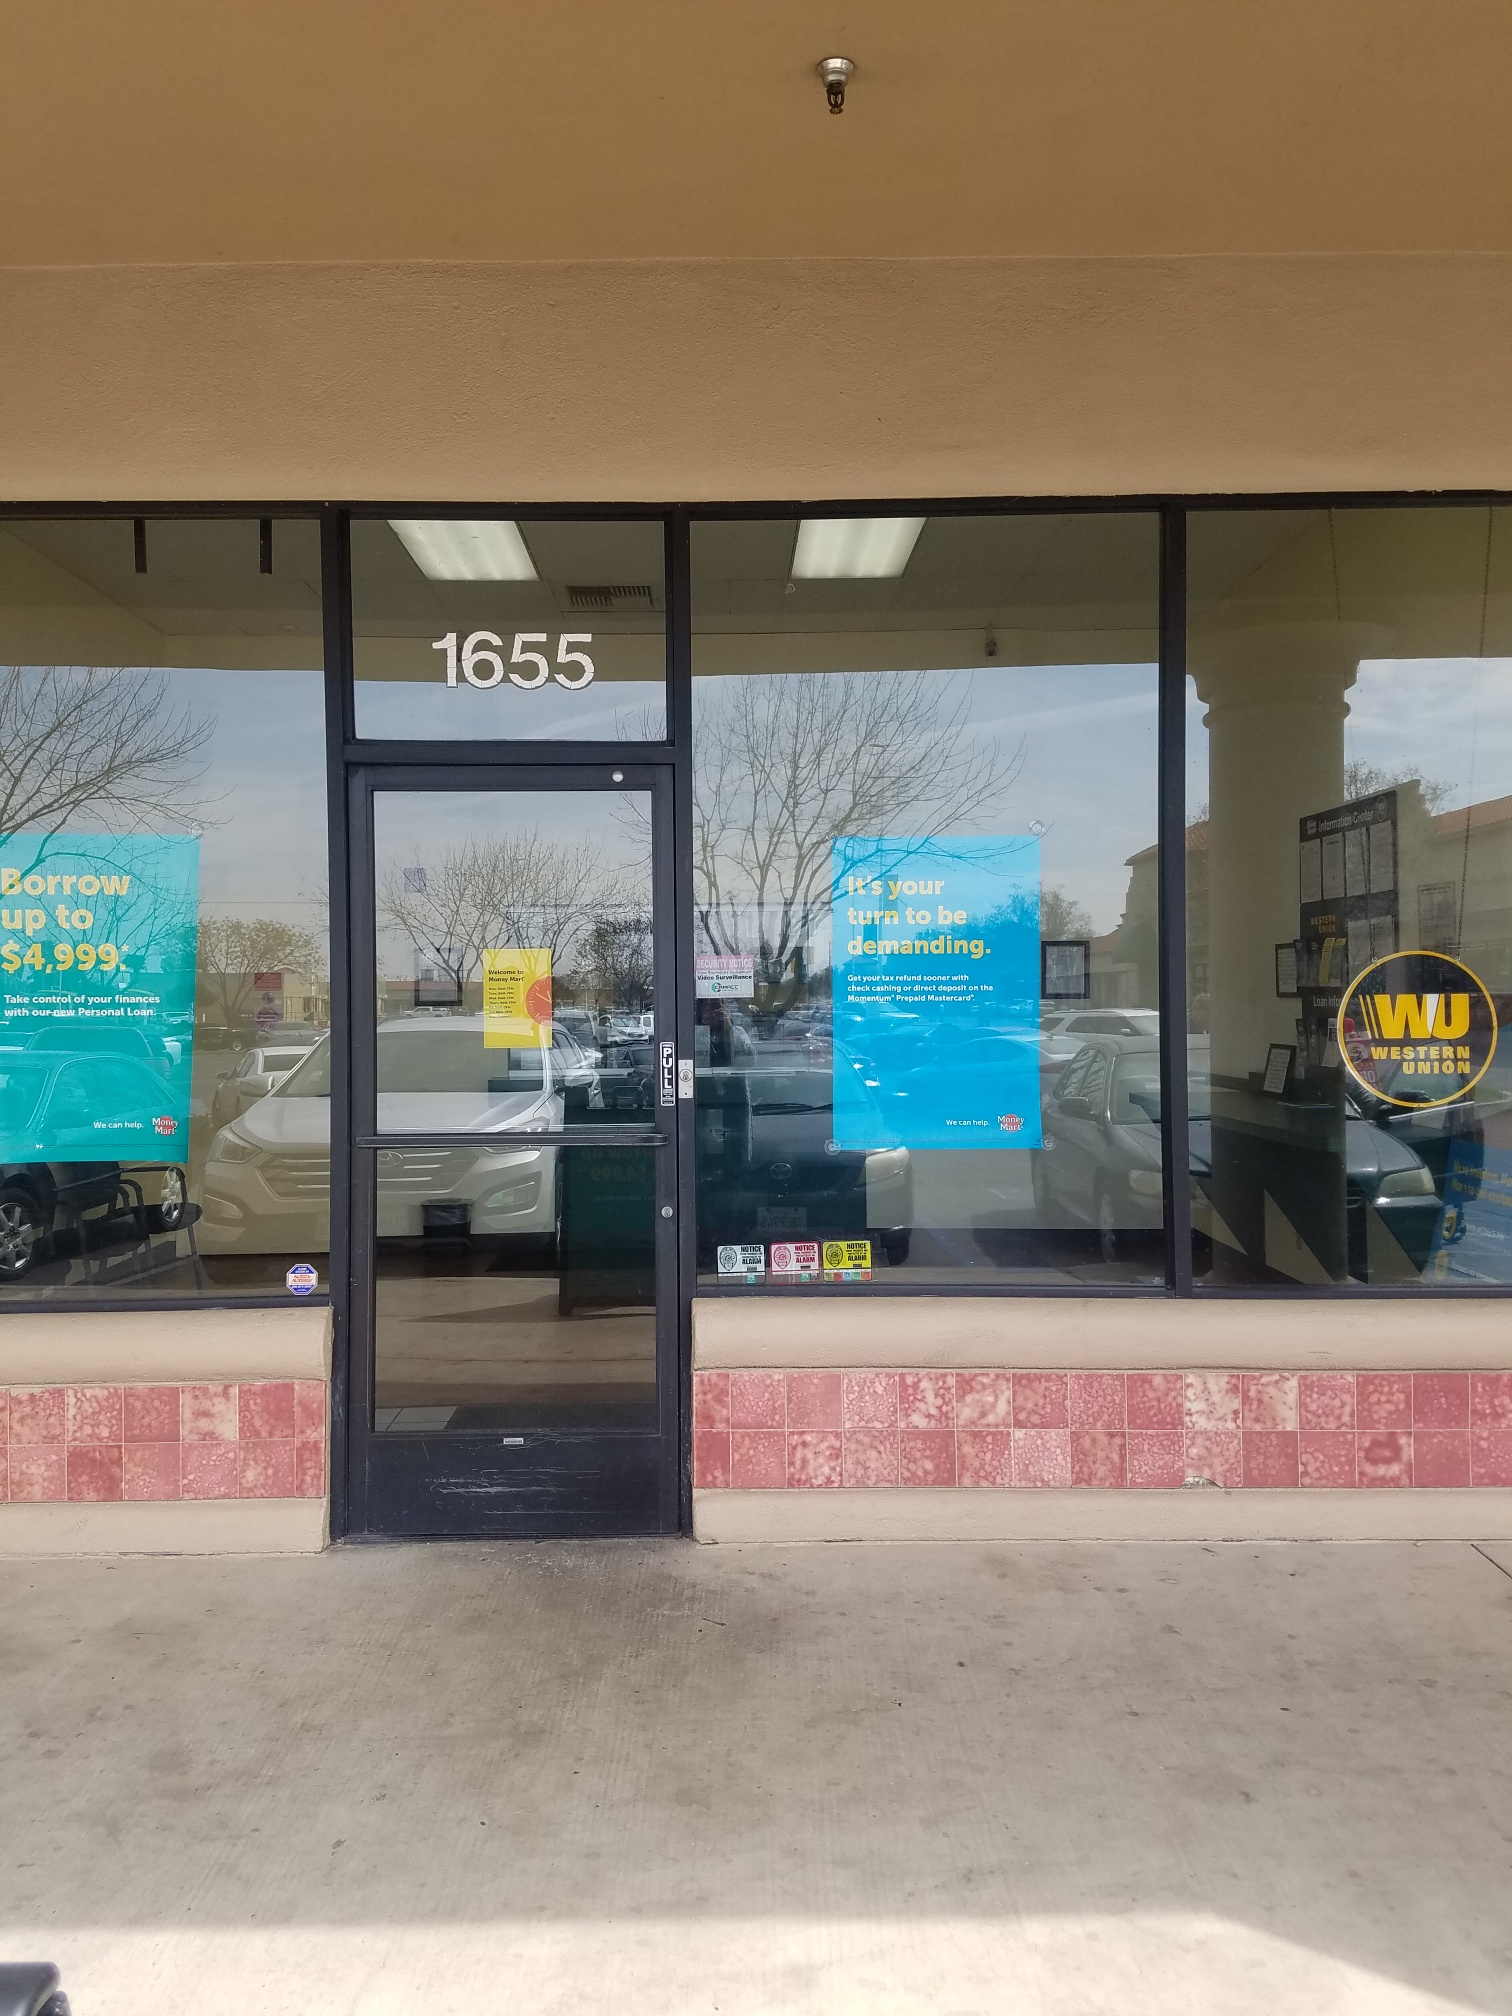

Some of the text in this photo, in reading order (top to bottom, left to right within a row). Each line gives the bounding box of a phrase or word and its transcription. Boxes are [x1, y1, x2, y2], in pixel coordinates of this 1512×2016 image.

[432, 631, 595, 690] 1655
[1319, 815, 1352, 832] Information
[1353, 809, 1374, 824] Center
[1, 868, 131, 895] Borrow
[848, 876, 945, 900] It's your
[1, 904, 94, 936] up to
[847, 905, 967, 925] turn to be
[1310, 913, 1336, 926] WESTERN
[1318, 922, 1336, 935] UNION
[847, 935, 992, 960] demanding.
[696, 958, 753, 969] SECURITY NOTICE
[847, 984, 871, 992] check
[872, 984, 902, 993] cashing
[913, 984, 936, 992] direct
[938, 984, 967, 993] deposit
[4, 995, 160, 1006] Take control of your finances
[896, 994, 926, 1003] Prepaid
[1313, 996, 1328, 1007] Loan
[4, 1007, 157, 1017] with our new Personal Loan.
[1373, 993, 1470, 1040] WU
[1370, 1046, 1470, 1060] WESTERN
[663, 1047, 673, 1089] PULL
[1402, 1060, 1471, 1075] UNION
[93, 1121, 106, 1129] We
[124, 1121, 144, 1130] help.
[152, 1117, 179, 1128] Money
[972, 1119, 990, 1127] help.
[997, 1115, 1025, 1125] Money
[740, 1245, 762, 1253] NOTICE
[795, 1244, 816, 1252] NOTICE
[846, 1242, 867, 1250] NOTICE
[795, 1256, 816, 1264] ALARM
[847, 1254, 867, 1262] ALARM
